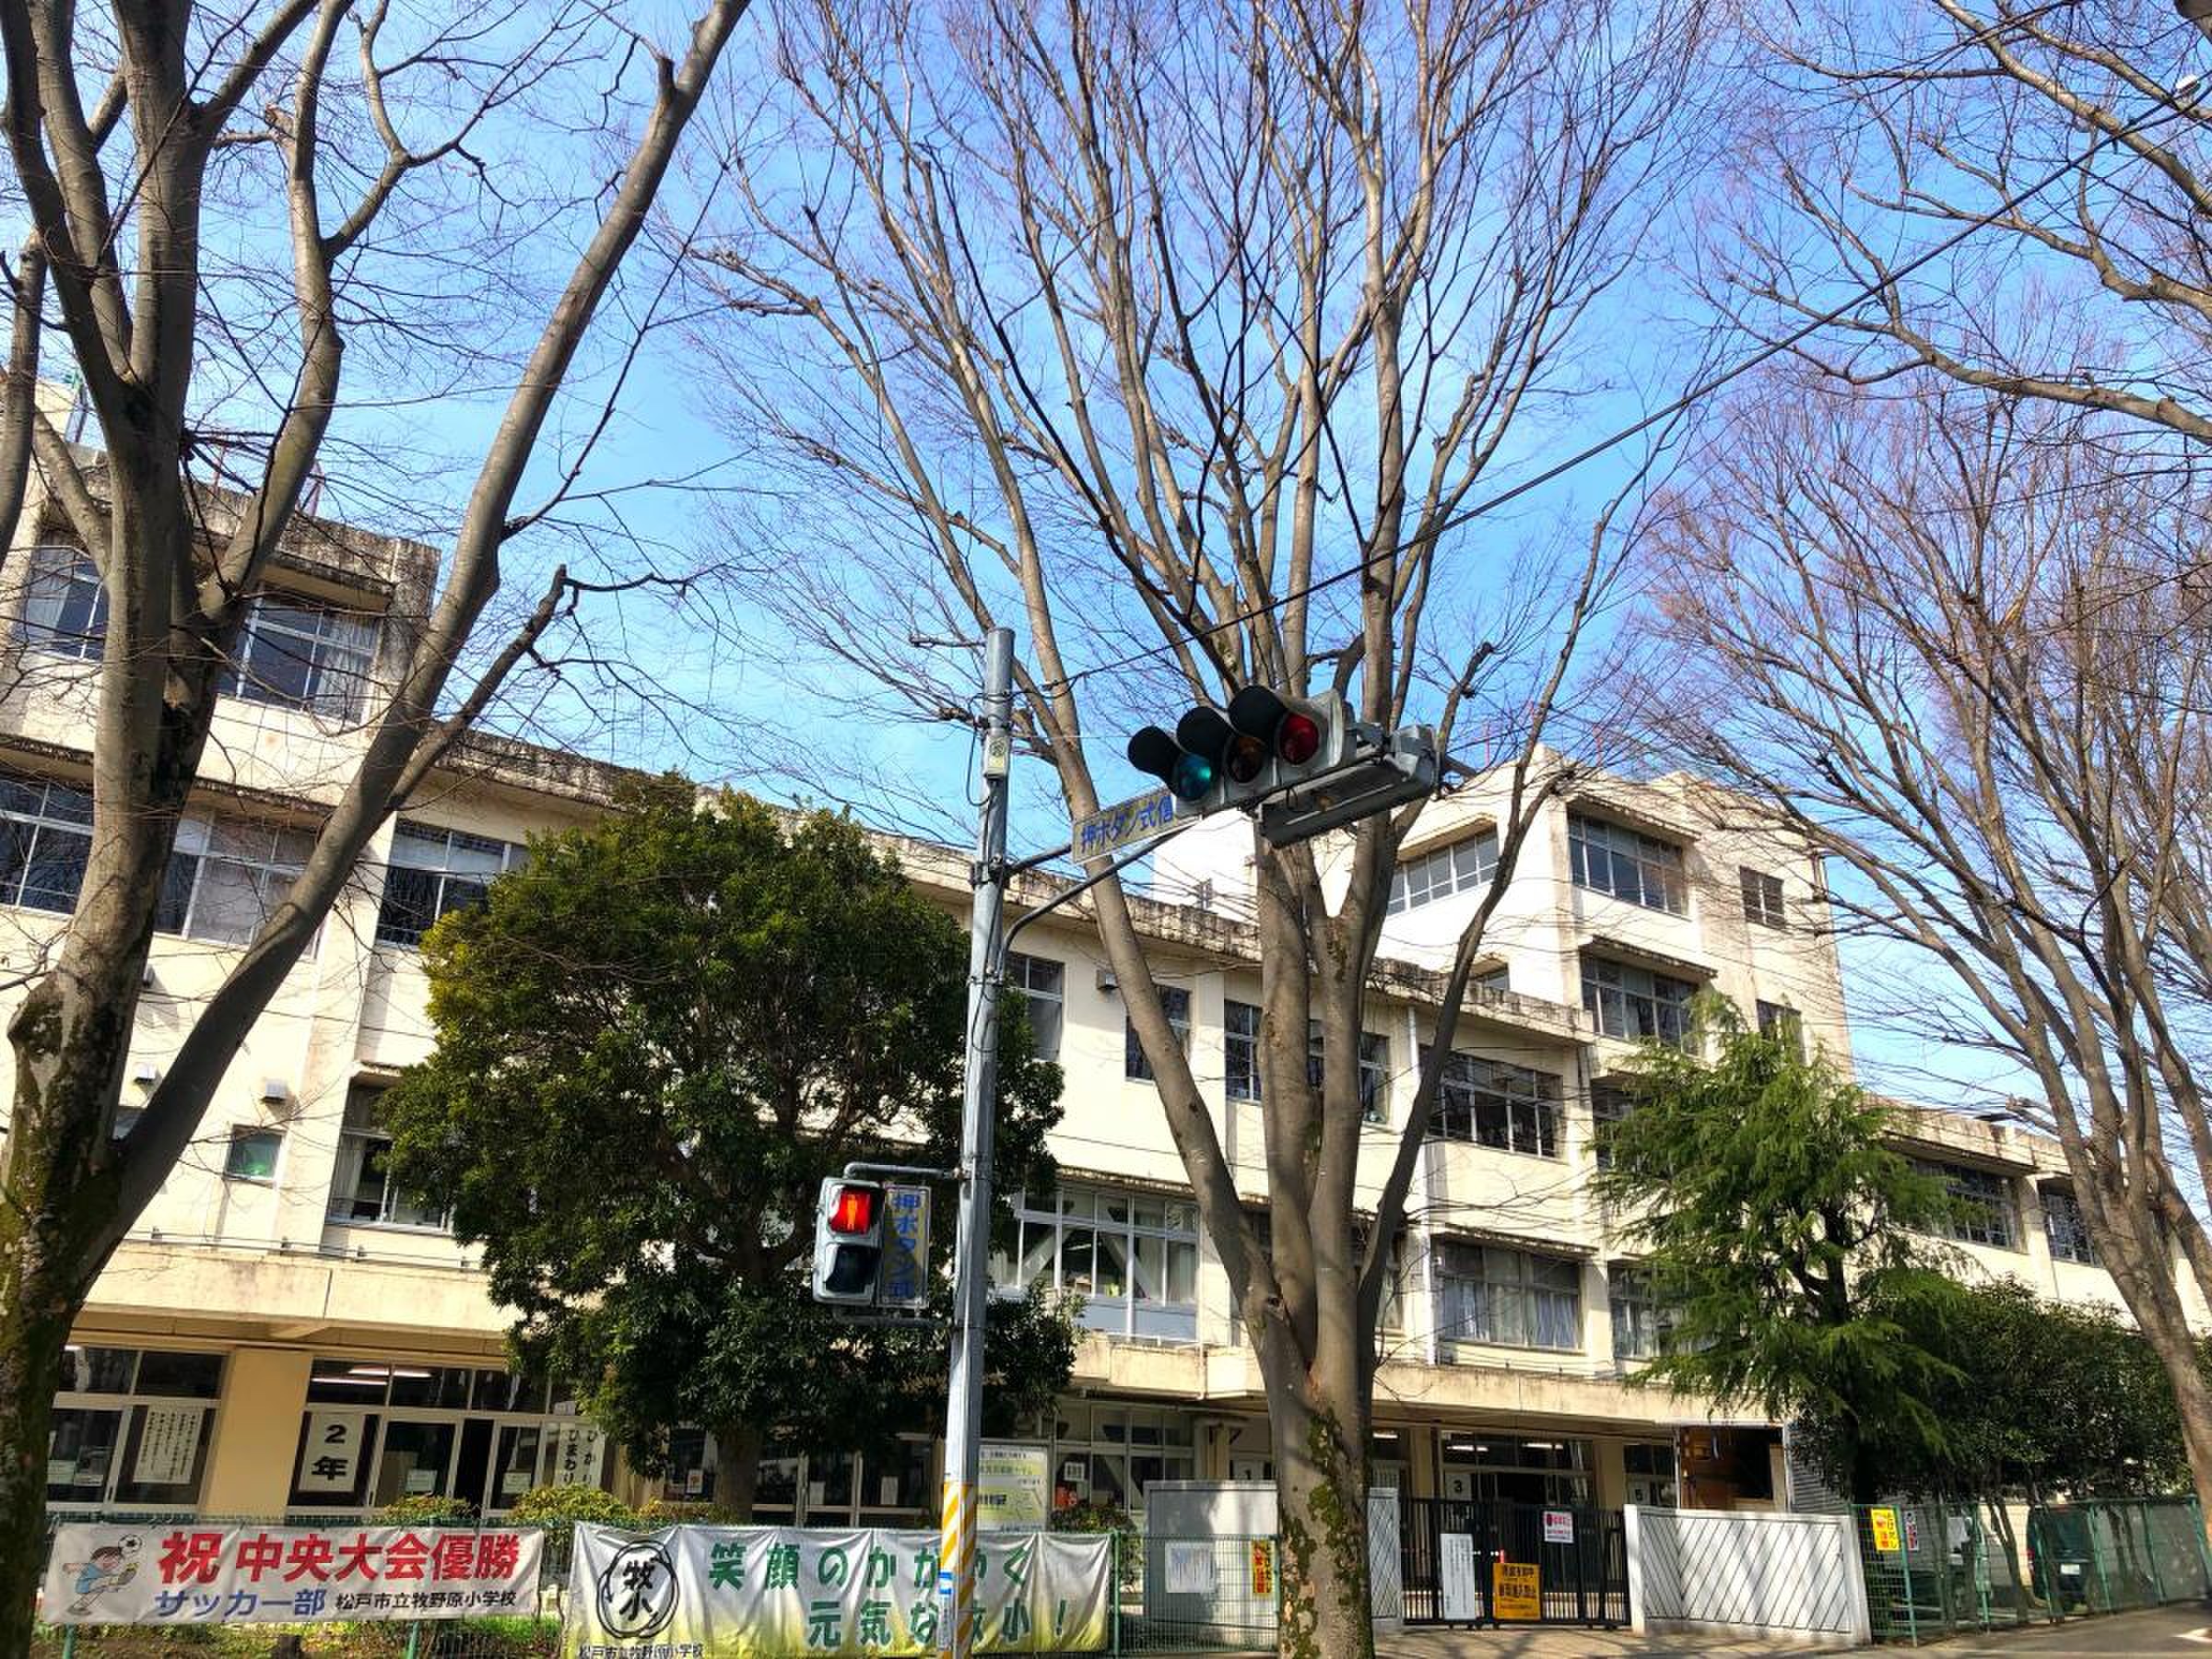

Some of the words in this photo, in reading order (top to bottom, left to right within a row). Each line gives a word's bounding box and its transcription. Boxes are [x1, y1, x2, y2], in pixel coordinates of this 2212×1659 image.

[158, 1532, 223, 1583] 祝
[236, 1532, 519, 1583] 中央大会優勝
[154, 1588, 327, 1618] サッカー部
[335, 1591, 517, 1611] 松戸市立牧野原小学校
